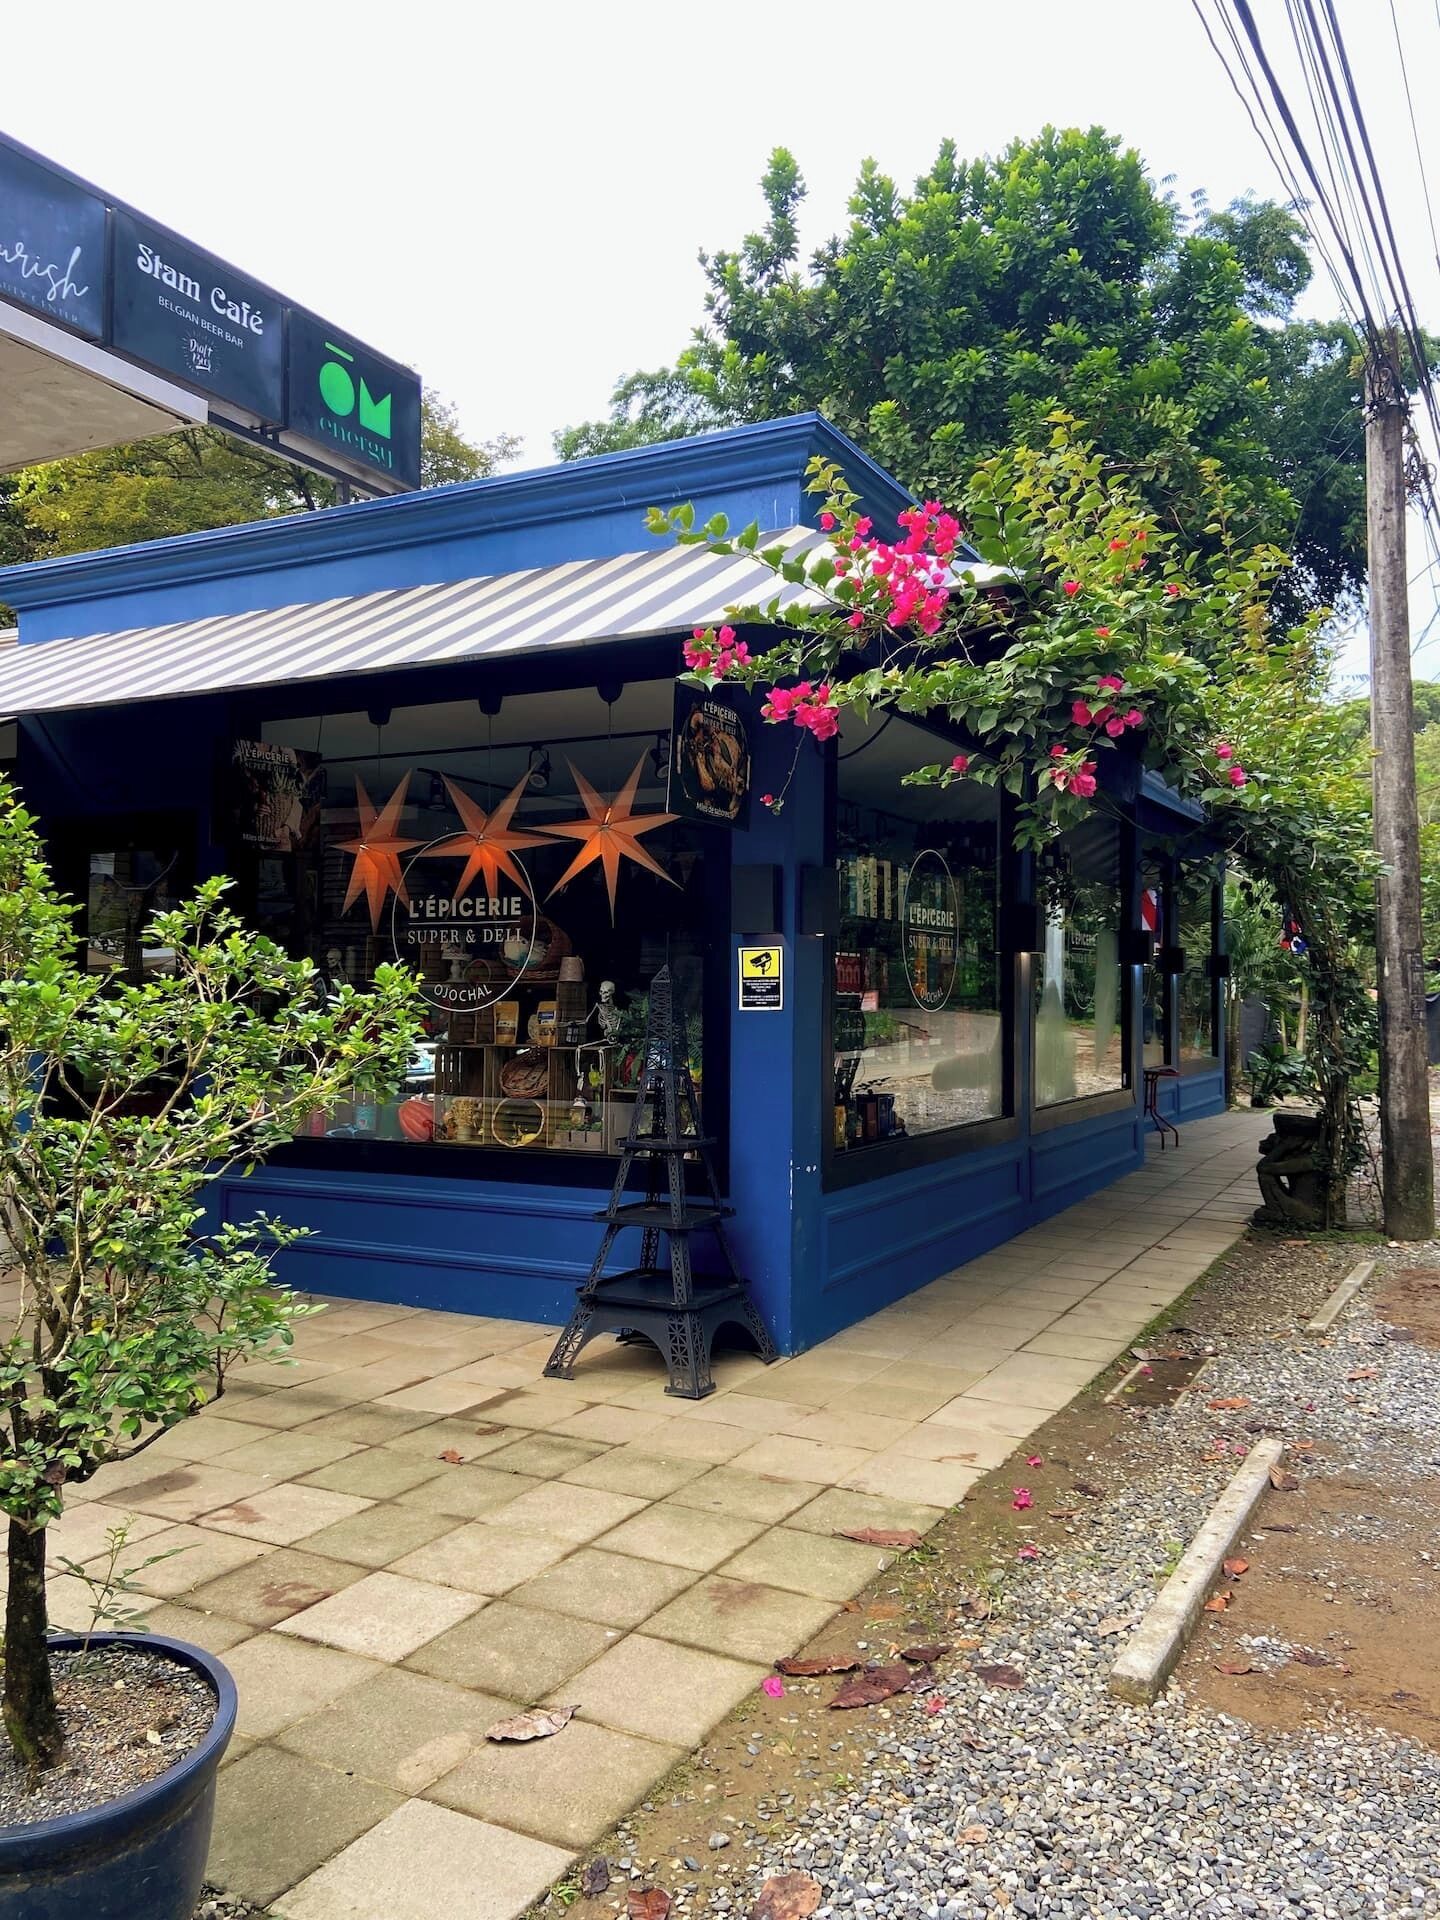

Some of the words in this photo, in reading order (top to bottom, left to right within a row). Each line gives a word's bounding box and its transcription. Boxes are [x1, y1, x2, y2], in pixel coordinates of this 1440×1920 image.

[137, 243, 201, 302] Stam
[210, 287, 264, 335] Café
[158, 296, 199, 325] BELGIAN
[200, 318, 224, 338] BEER
[225, 331, 244, 349] BAR
[409, 895, 521, 918] L'ÉPICERIE
[407, 929, 460, 944] SUPER
[465, 929, 477, 943] &
[483, 928, 521, 943] DELI
[434, 984, 493, 1002] OJOCHAL
